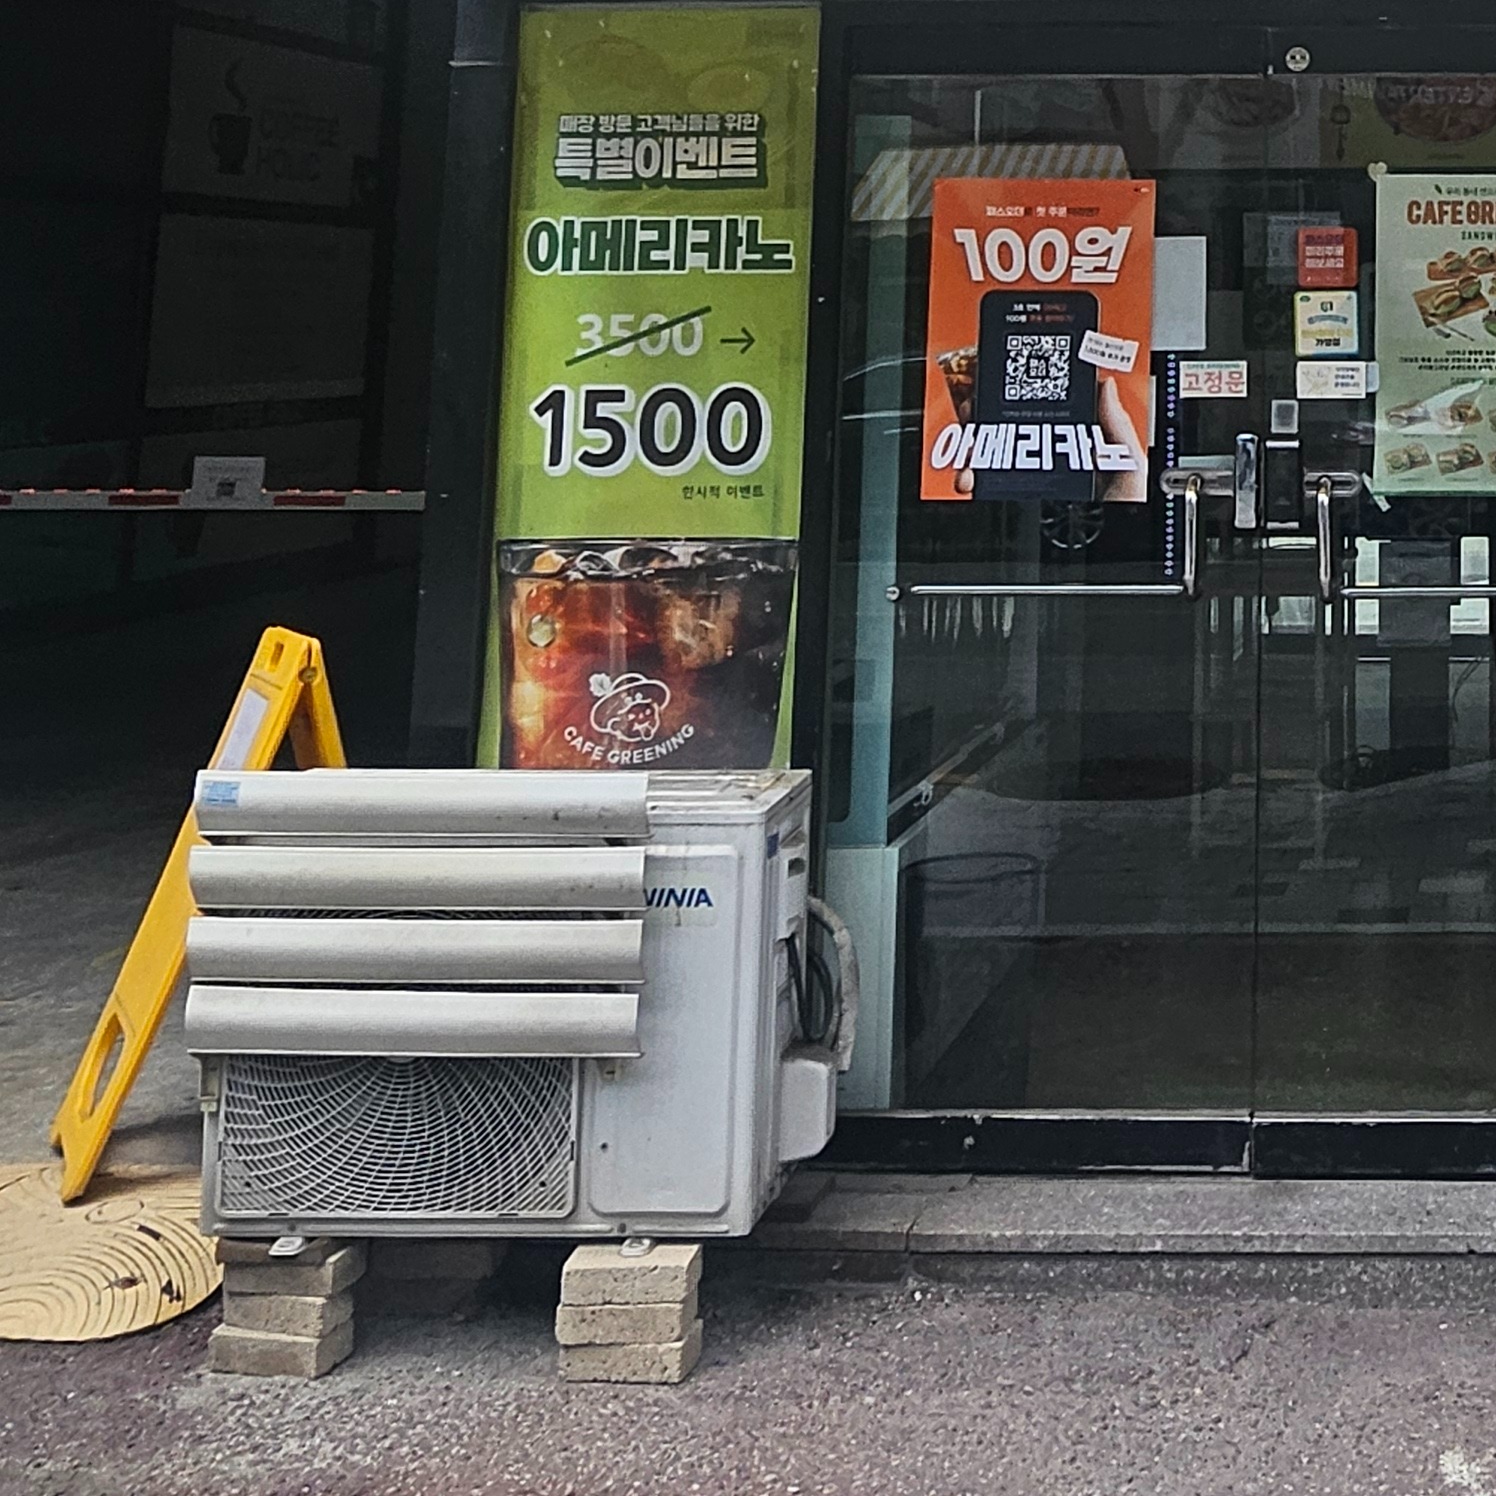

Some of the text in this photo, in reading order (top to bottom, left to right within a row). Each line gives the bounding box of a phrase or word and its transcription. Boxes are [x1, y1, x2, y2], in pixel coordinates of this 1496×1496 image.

[559, 112, 760, 133] 매장 방문 고객님들을 위한
[555, 136, 758, 181] 특별이벤트
[1407, 200, 1463, 225] CAFE
[526, 217, 795, 273] 아메리카노
[953, 226, 1133, 284] 100원
[575, 313, 704, 357] 3500
[1182, 370, 1246, 394] 고정문
[532, 384, 766, 471] 1500
[931, 423, 1139, 471] 아메리카노
[563, 723, 695, 765] CAFE GREENING
